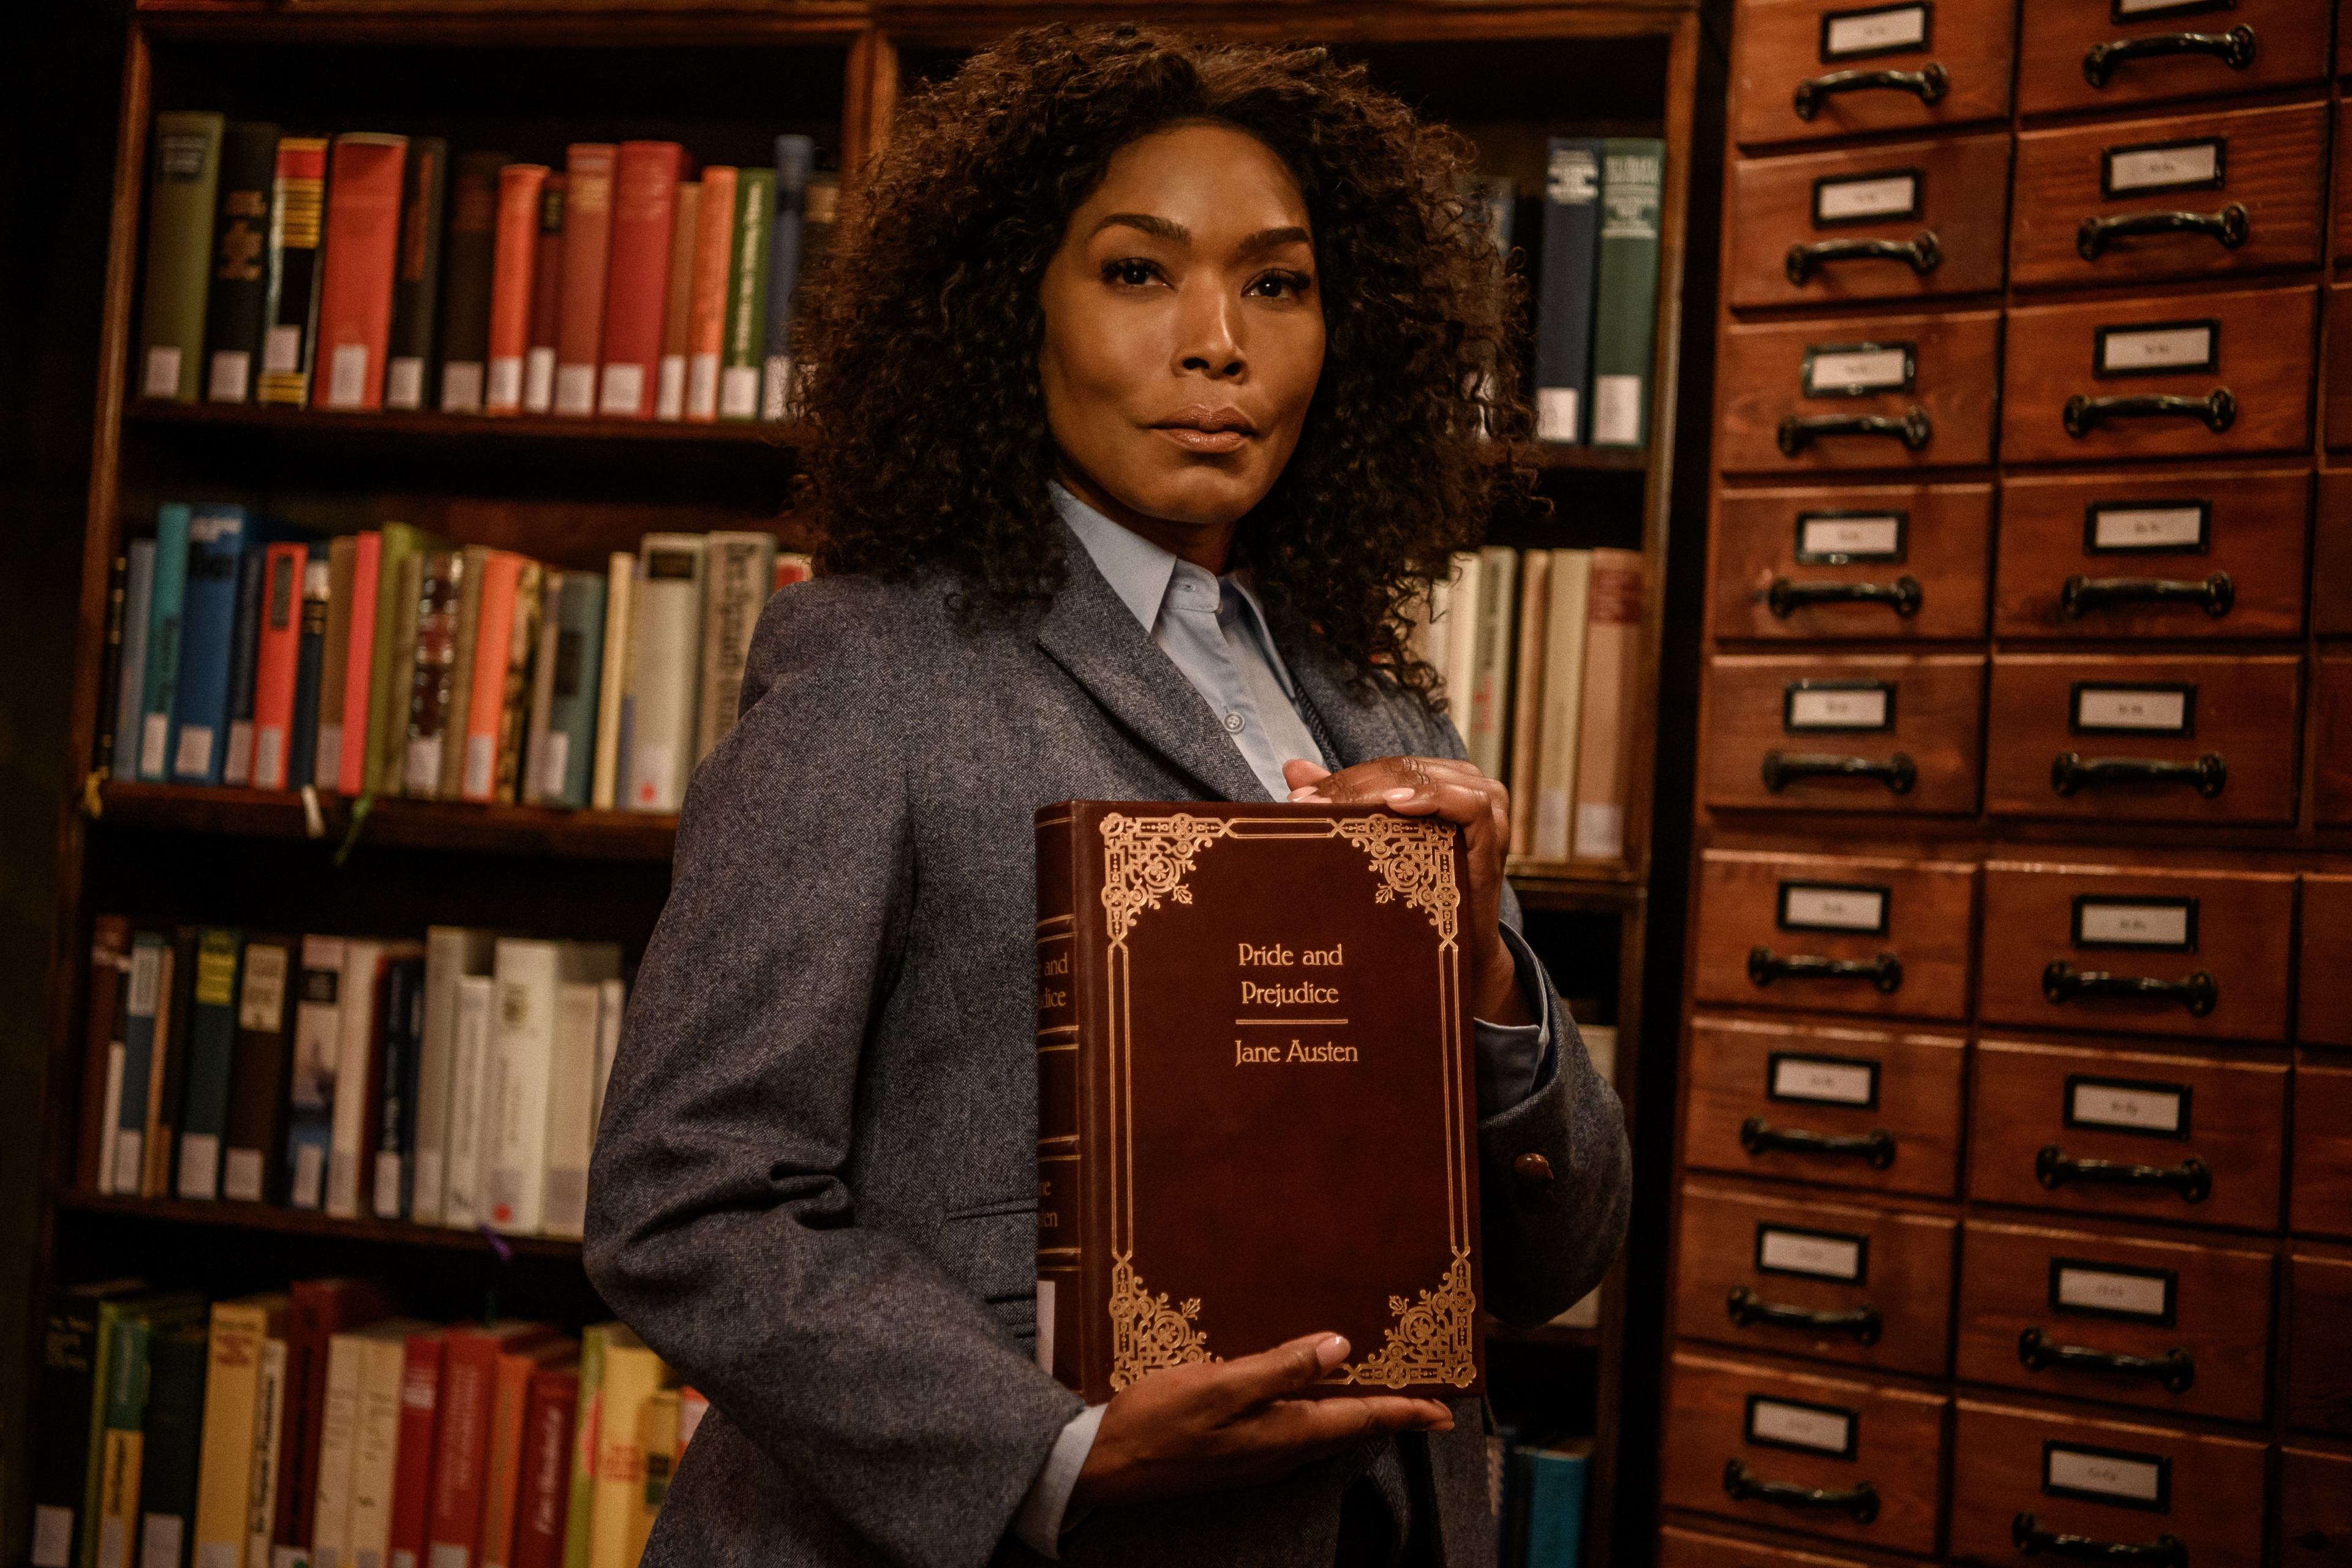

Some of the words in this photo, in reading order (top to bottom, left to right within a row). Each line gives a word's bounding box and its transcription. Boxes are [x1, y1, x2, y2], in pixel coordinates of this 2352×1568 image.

[1044, 952, 1069, 976] and
[1238, 943, 1294, 966] Pride
[1302, 943, 1343, 966] and
[1242, 981, 1339, 1007] Prejudice
[1235, 1040, 1281, 1067] Jane
[1286, 1039, 1359, 1062] Austen
